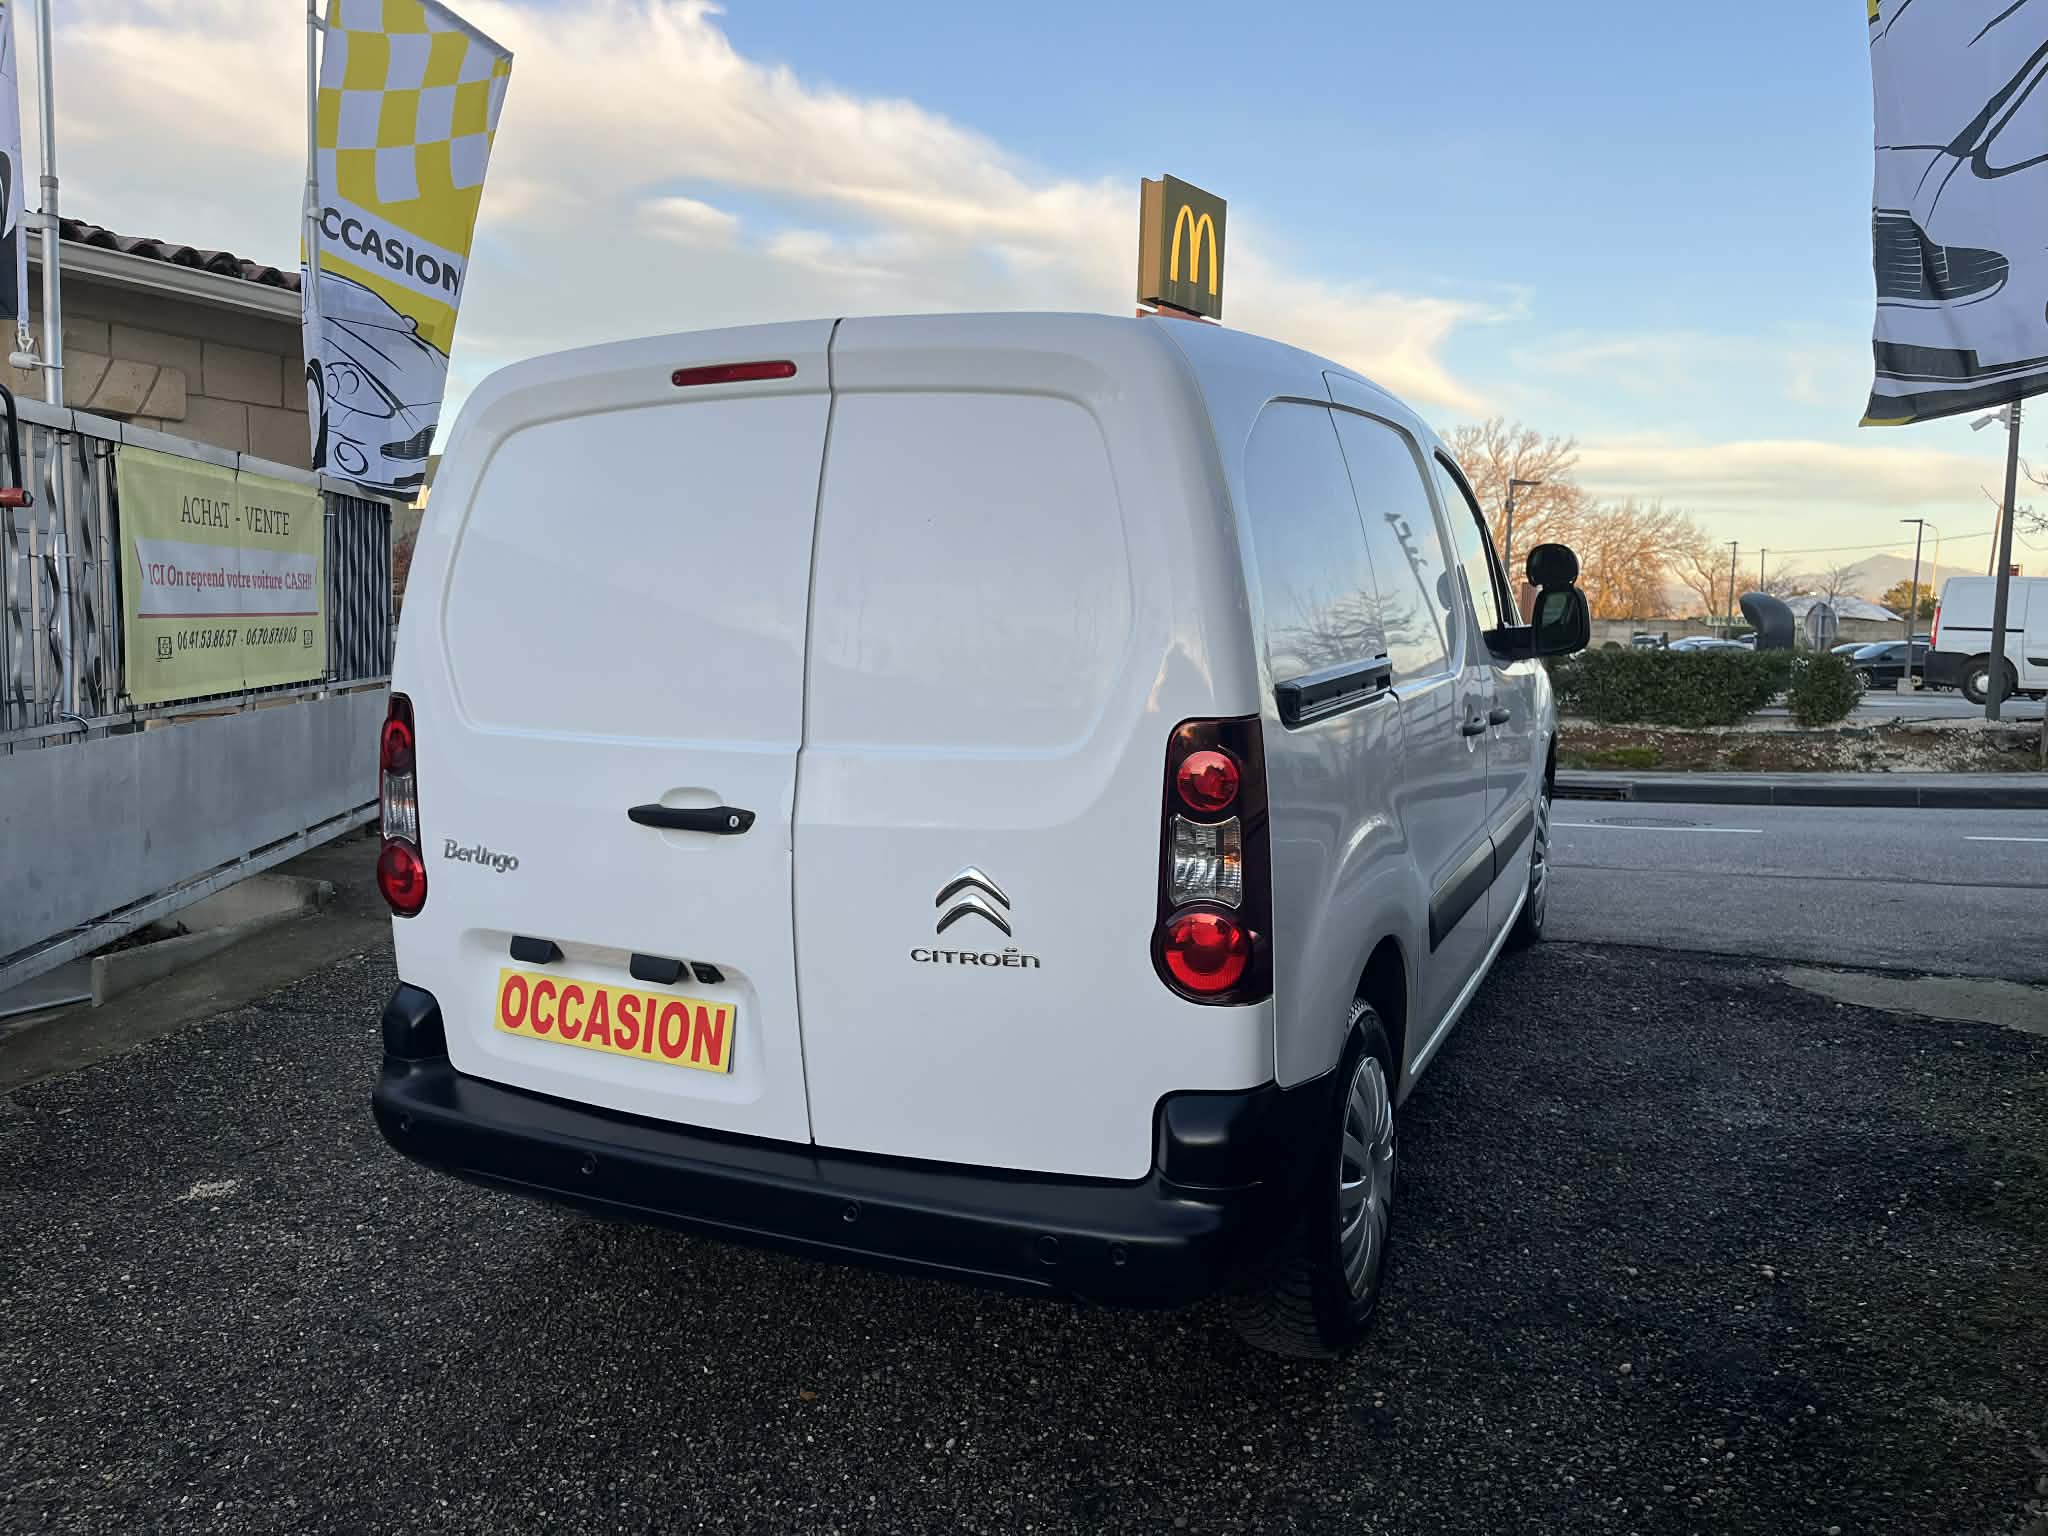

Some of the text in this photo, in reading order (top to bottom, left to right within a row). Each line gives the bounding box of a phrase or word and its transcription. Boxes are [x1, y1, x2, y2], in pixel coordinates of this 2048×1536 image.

[319, 207, 461, 296] CCASION
[181, 496, 230, 528] ACHAT
[245, 506, 290, 535] VENTE
[148, 564, 165, 586] ICI
[168, 564, 183, 586] On
[185, 568, 224, 592] reprend
[226, 571, 250, 588] votre
[252, 569, 282, 590] voiture
[444, 839, 519, 873] Berlingo
[501, 975, 726, 1066] OCCASION
